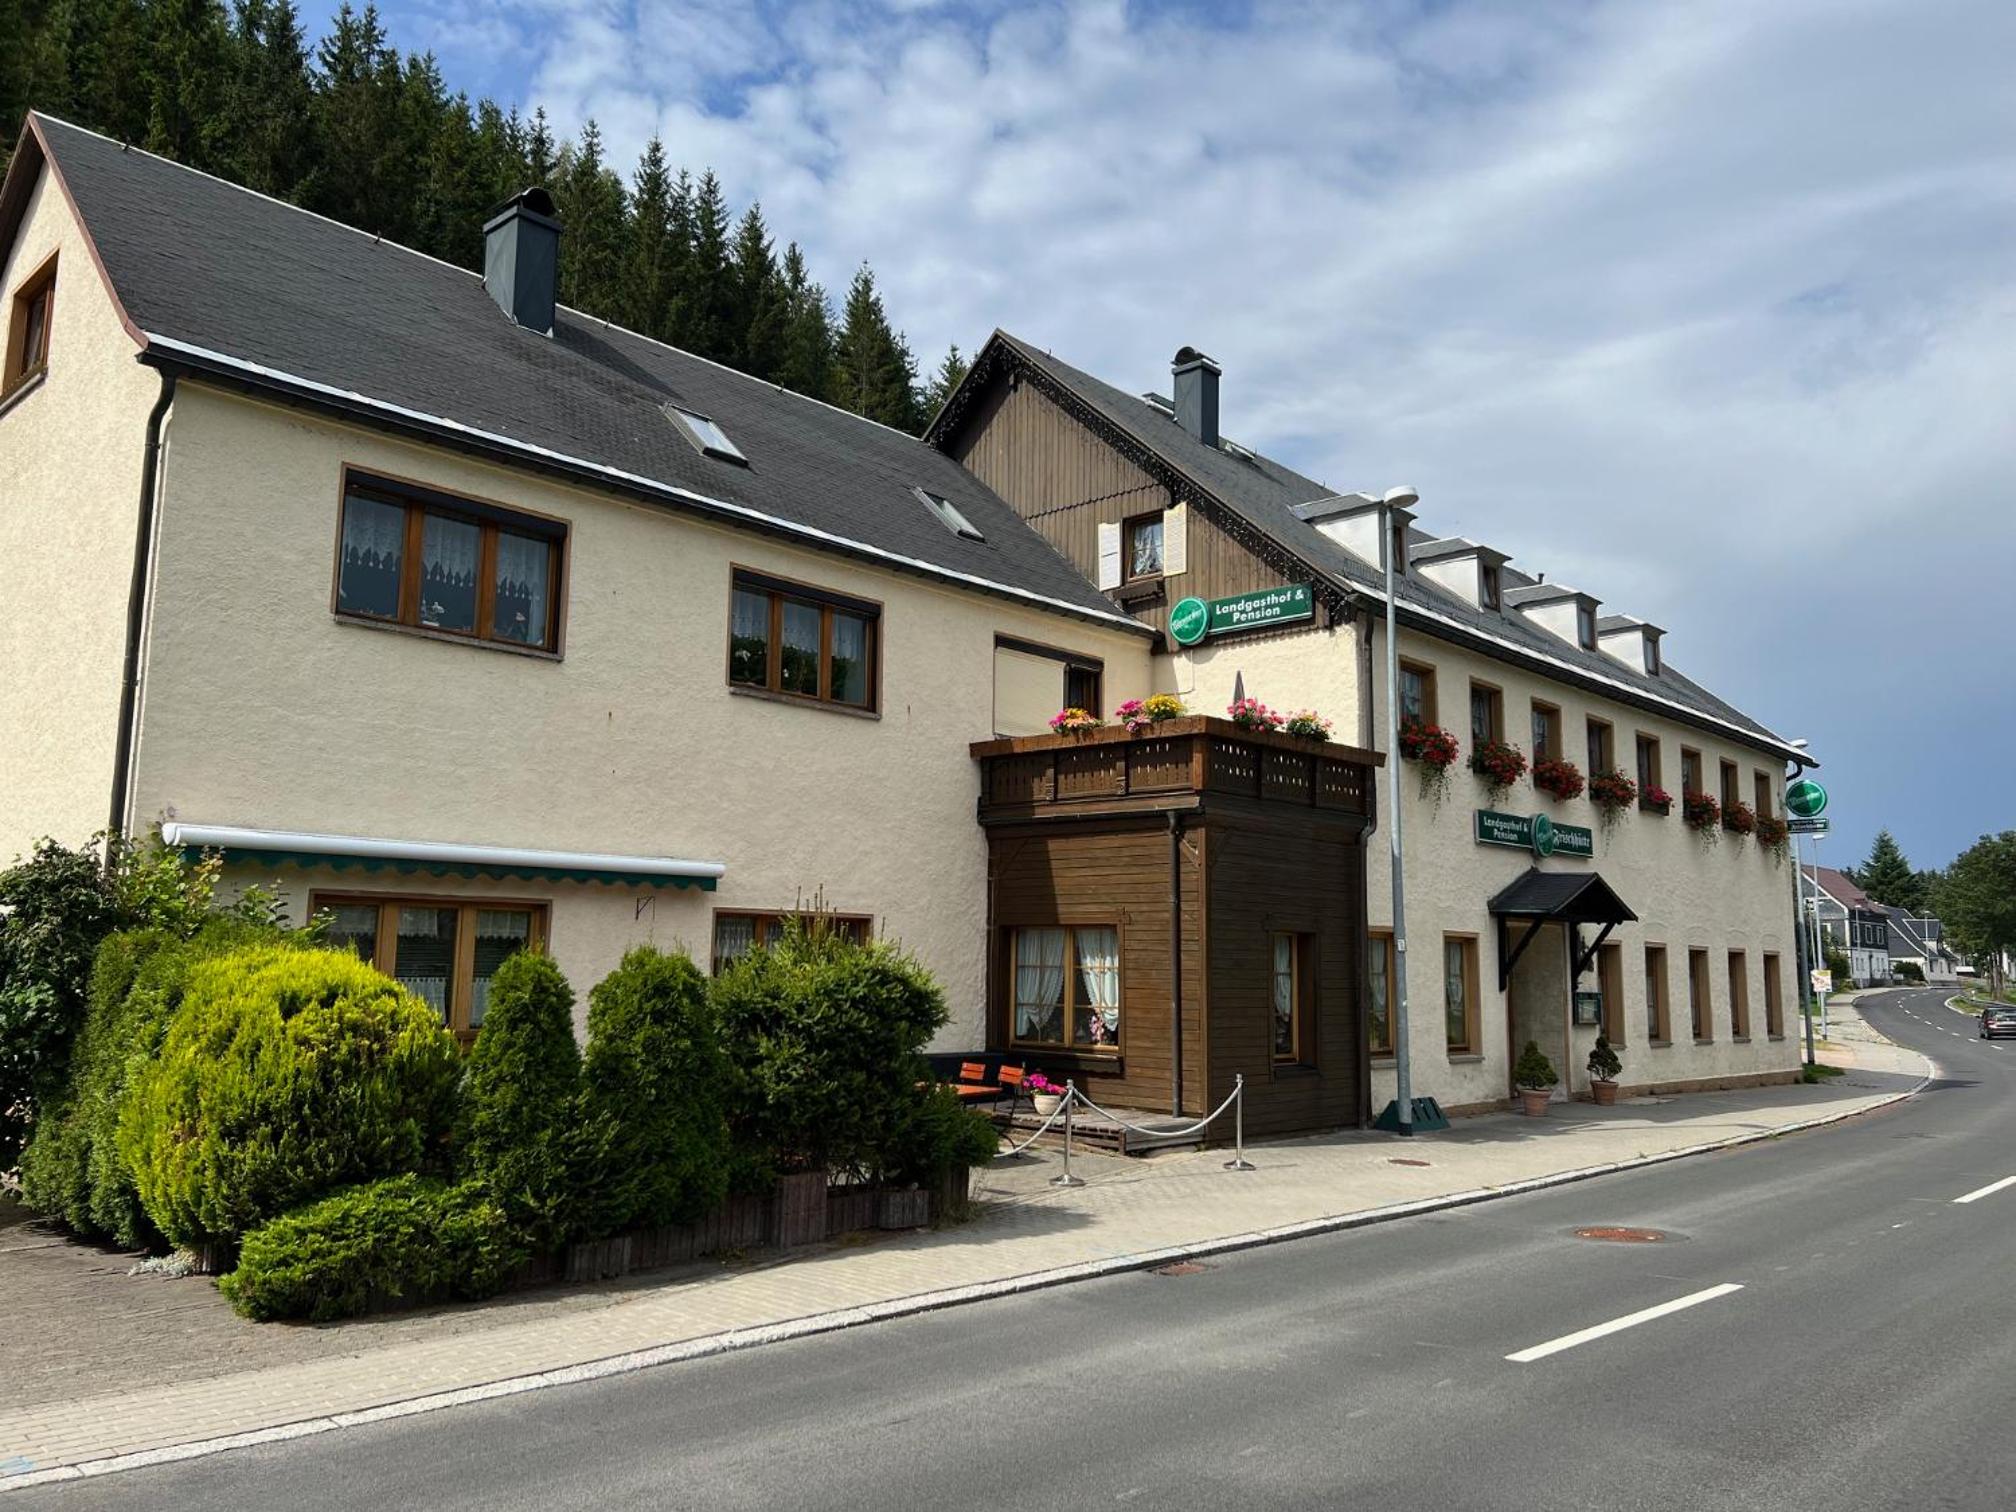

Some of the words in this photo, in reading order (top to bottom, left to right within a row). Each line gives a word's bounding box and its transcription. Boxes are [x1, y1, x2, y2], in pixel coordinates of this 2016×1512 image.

[1215, 593, 1291, 615] Landgasthof
[1295, 589, 1304, 600] &
[1232, 607, 1281, 623] Pension
[1493, 828, 1519, 841] Pension
